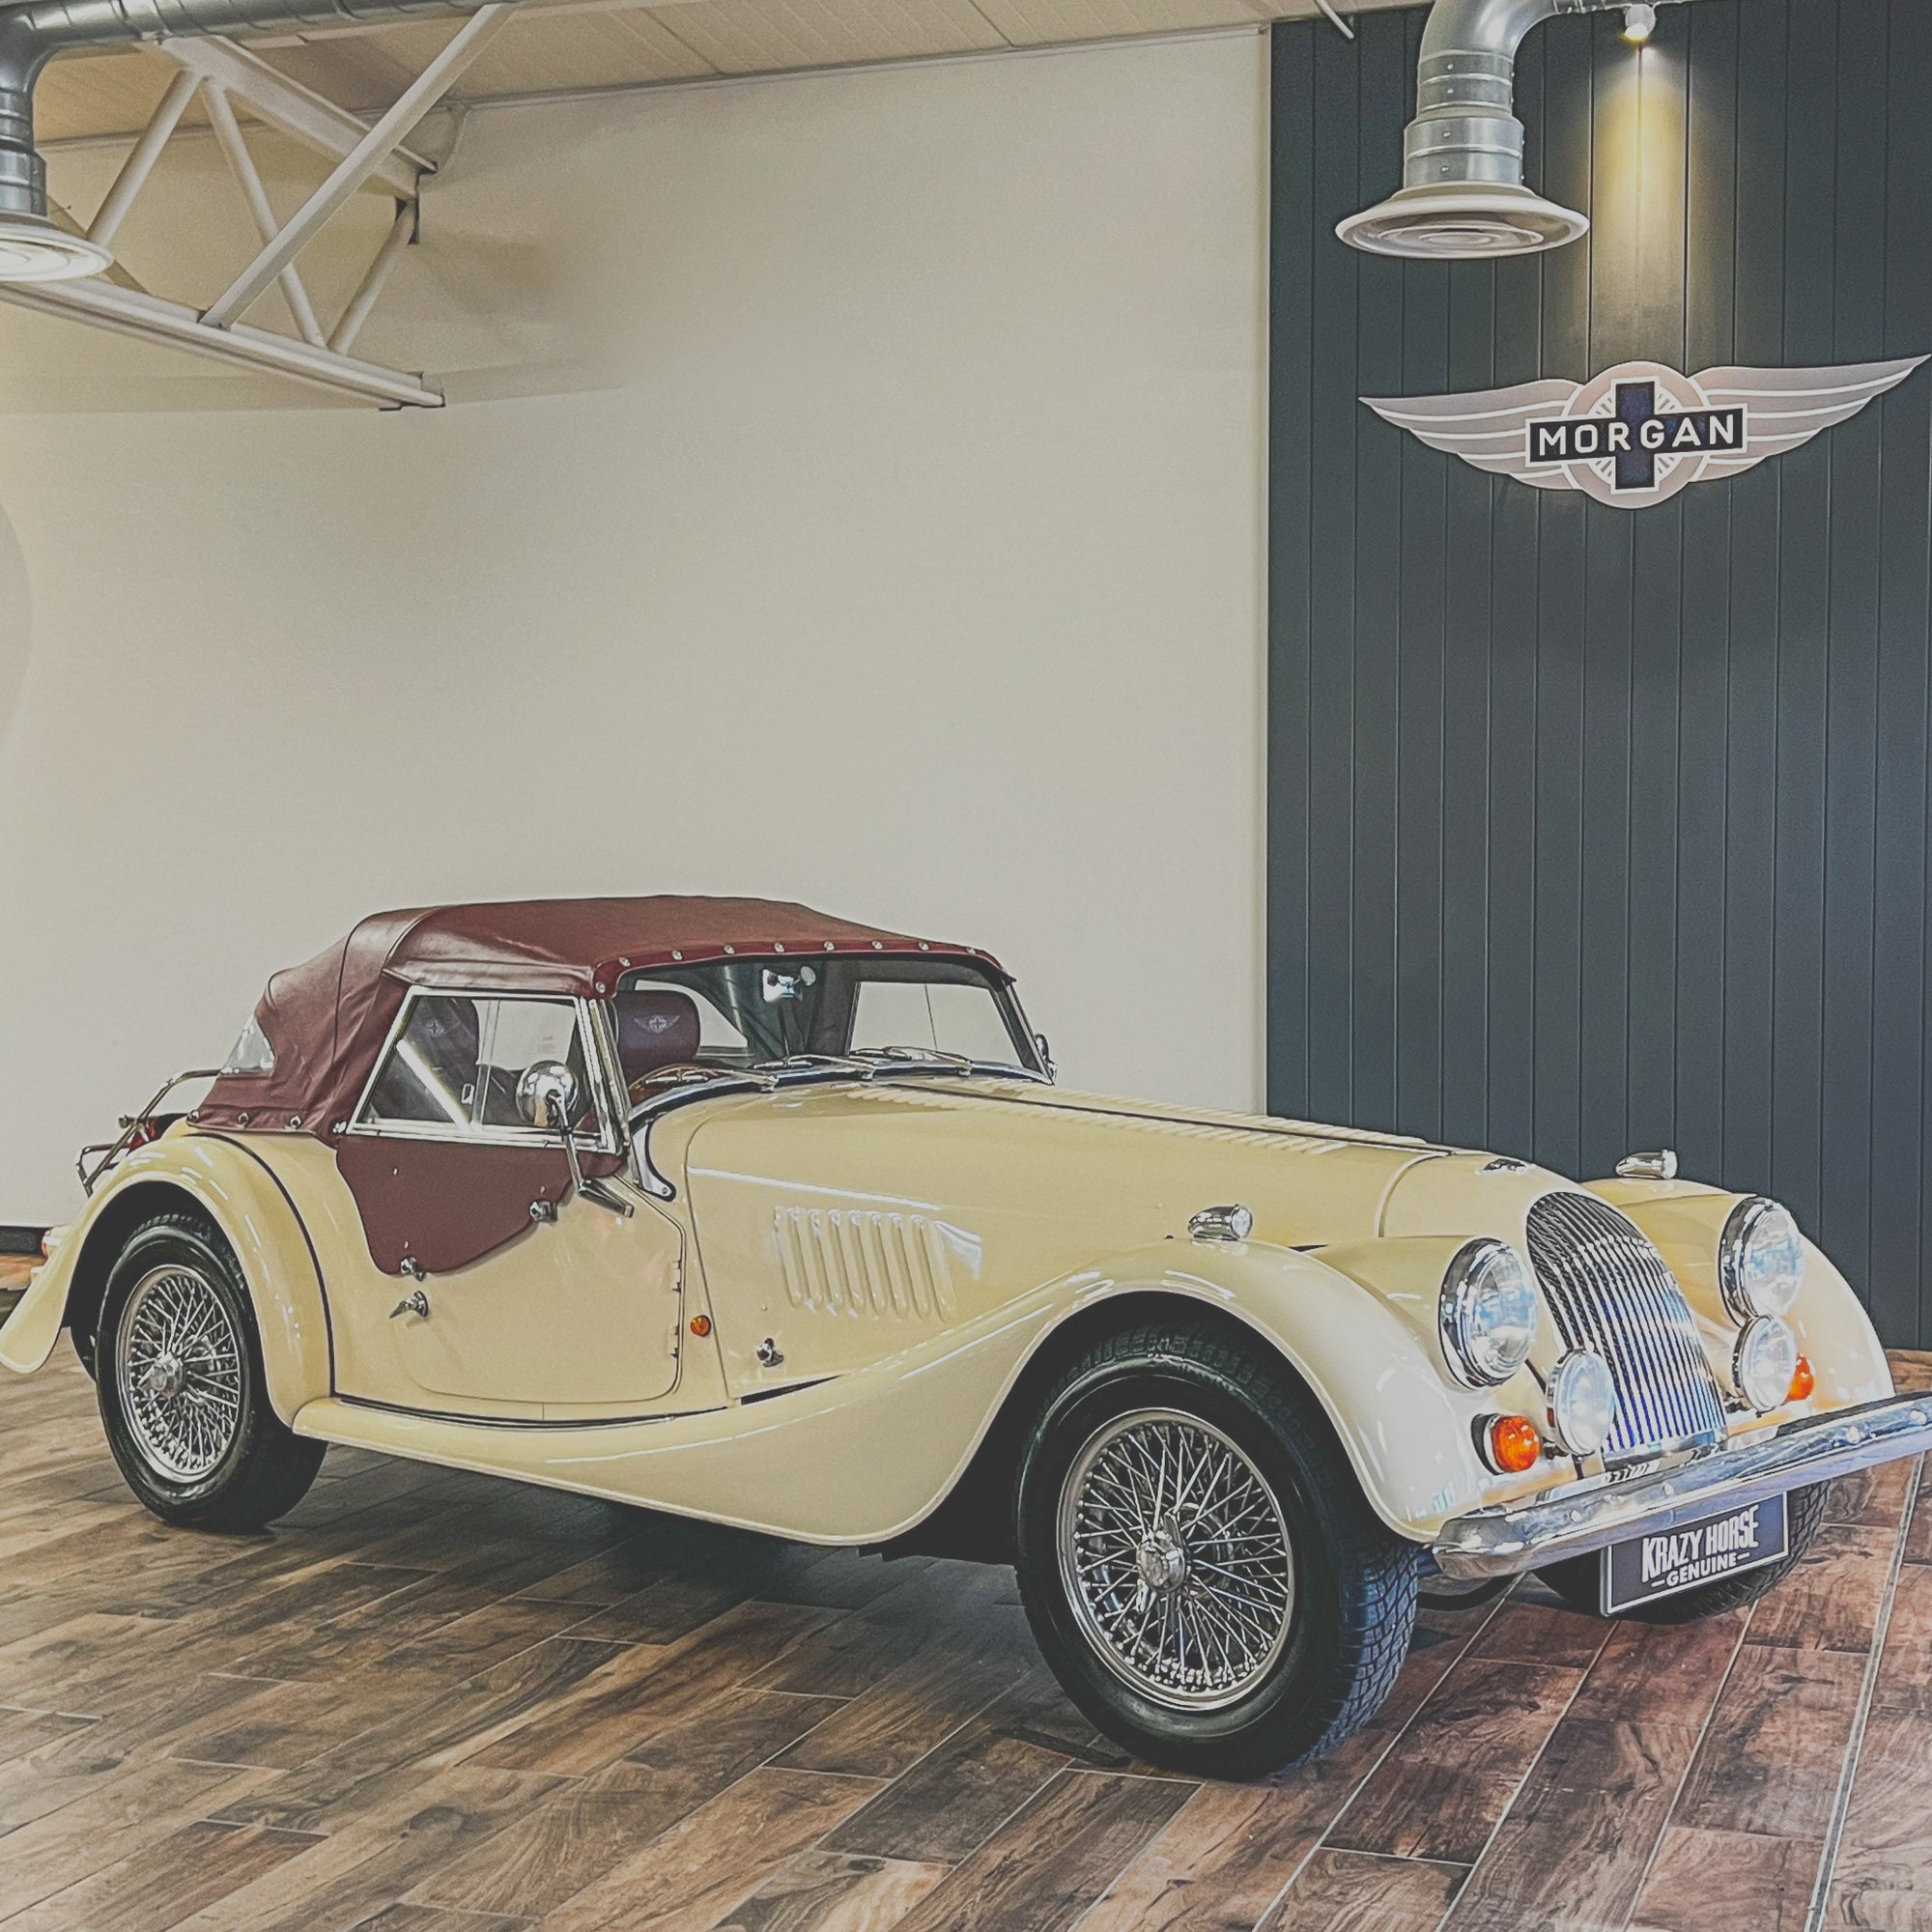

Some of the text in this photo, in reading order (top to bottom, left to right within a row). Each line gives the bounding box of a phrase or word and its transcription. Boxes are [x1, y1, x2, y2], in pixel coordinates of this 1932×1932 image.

[1539, 414, 1734, 456] MORGAN
[1642, 1505, 1759, 1583] KRAZY HORSE
